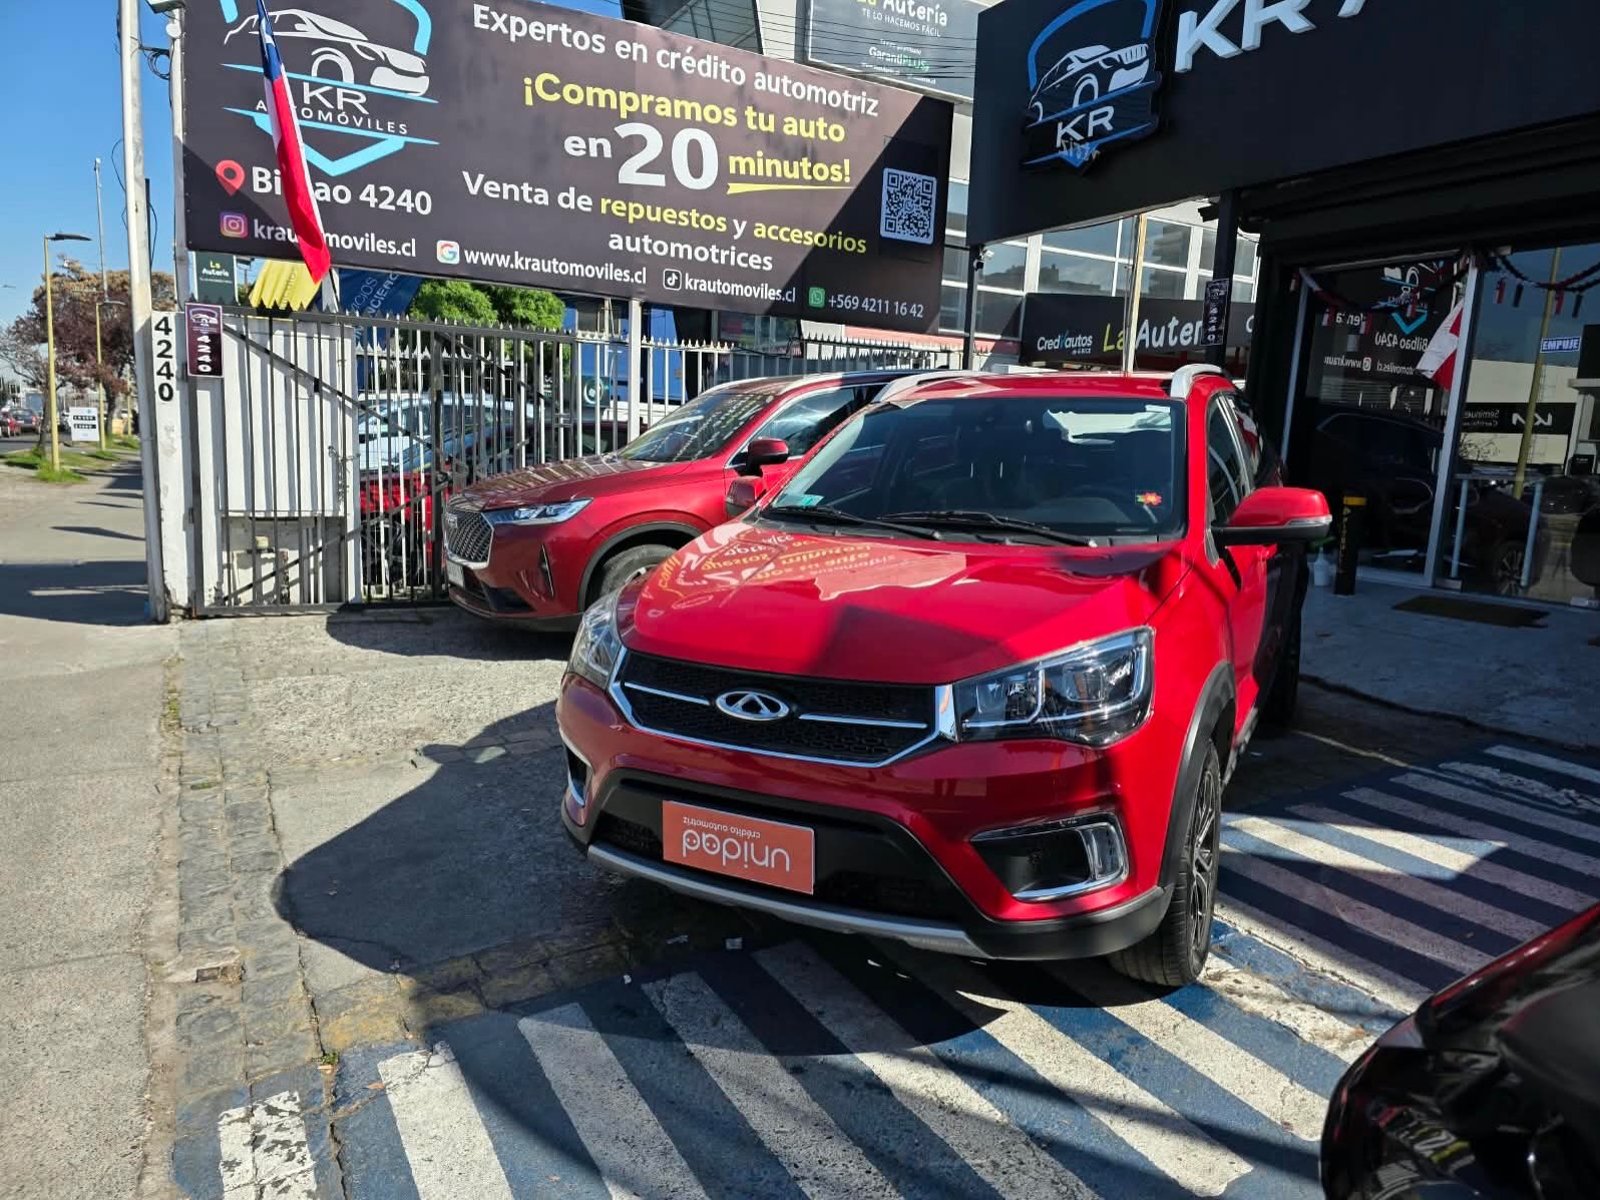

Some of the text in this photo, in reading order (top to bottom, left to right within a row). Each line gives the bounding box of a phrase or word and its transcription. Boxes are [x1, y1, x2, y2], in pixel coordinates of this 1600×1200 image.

[473, 3, 606, 54] Expertos
[615, 38, 648, 63] en
[656, 46, 746, 85] crédito
[754, 71, 879, 117] automotriz
[256, 99, 408, 135] AOMÓVILES
[303, 82, 369, 115] KR
[524, 72, 846, 143] ¡Compramos tu auto
[1056, 105, 1115, 149] KR
[564, 122, 852, 191] en 20 minutos!
[252, 166, 432, 216] Biao 4240
[462, 171, 867, 255] Venta de repuestos y accesorios
[254, 219, 416, 258] kraumoviles.cl
[608, 232, 773, 271] automotrices
[464, 249, 646, 285] www.krautomoviles.cl
[685, 273, 796, 303] krautomoviles.cl
[829, 294, 861, 310] +569
[862, 298, 890, 314] 4211
[1103, 316, 1202, 352] La Auter
[1542, 338, 1580, 351] EMPUJE
[154, 316, 174, 402] 4240
[197, 335, 212, 373] 4240
[683, 816, 761, 840] crédito automotriz
[682, 829, 790, 873] unidad
